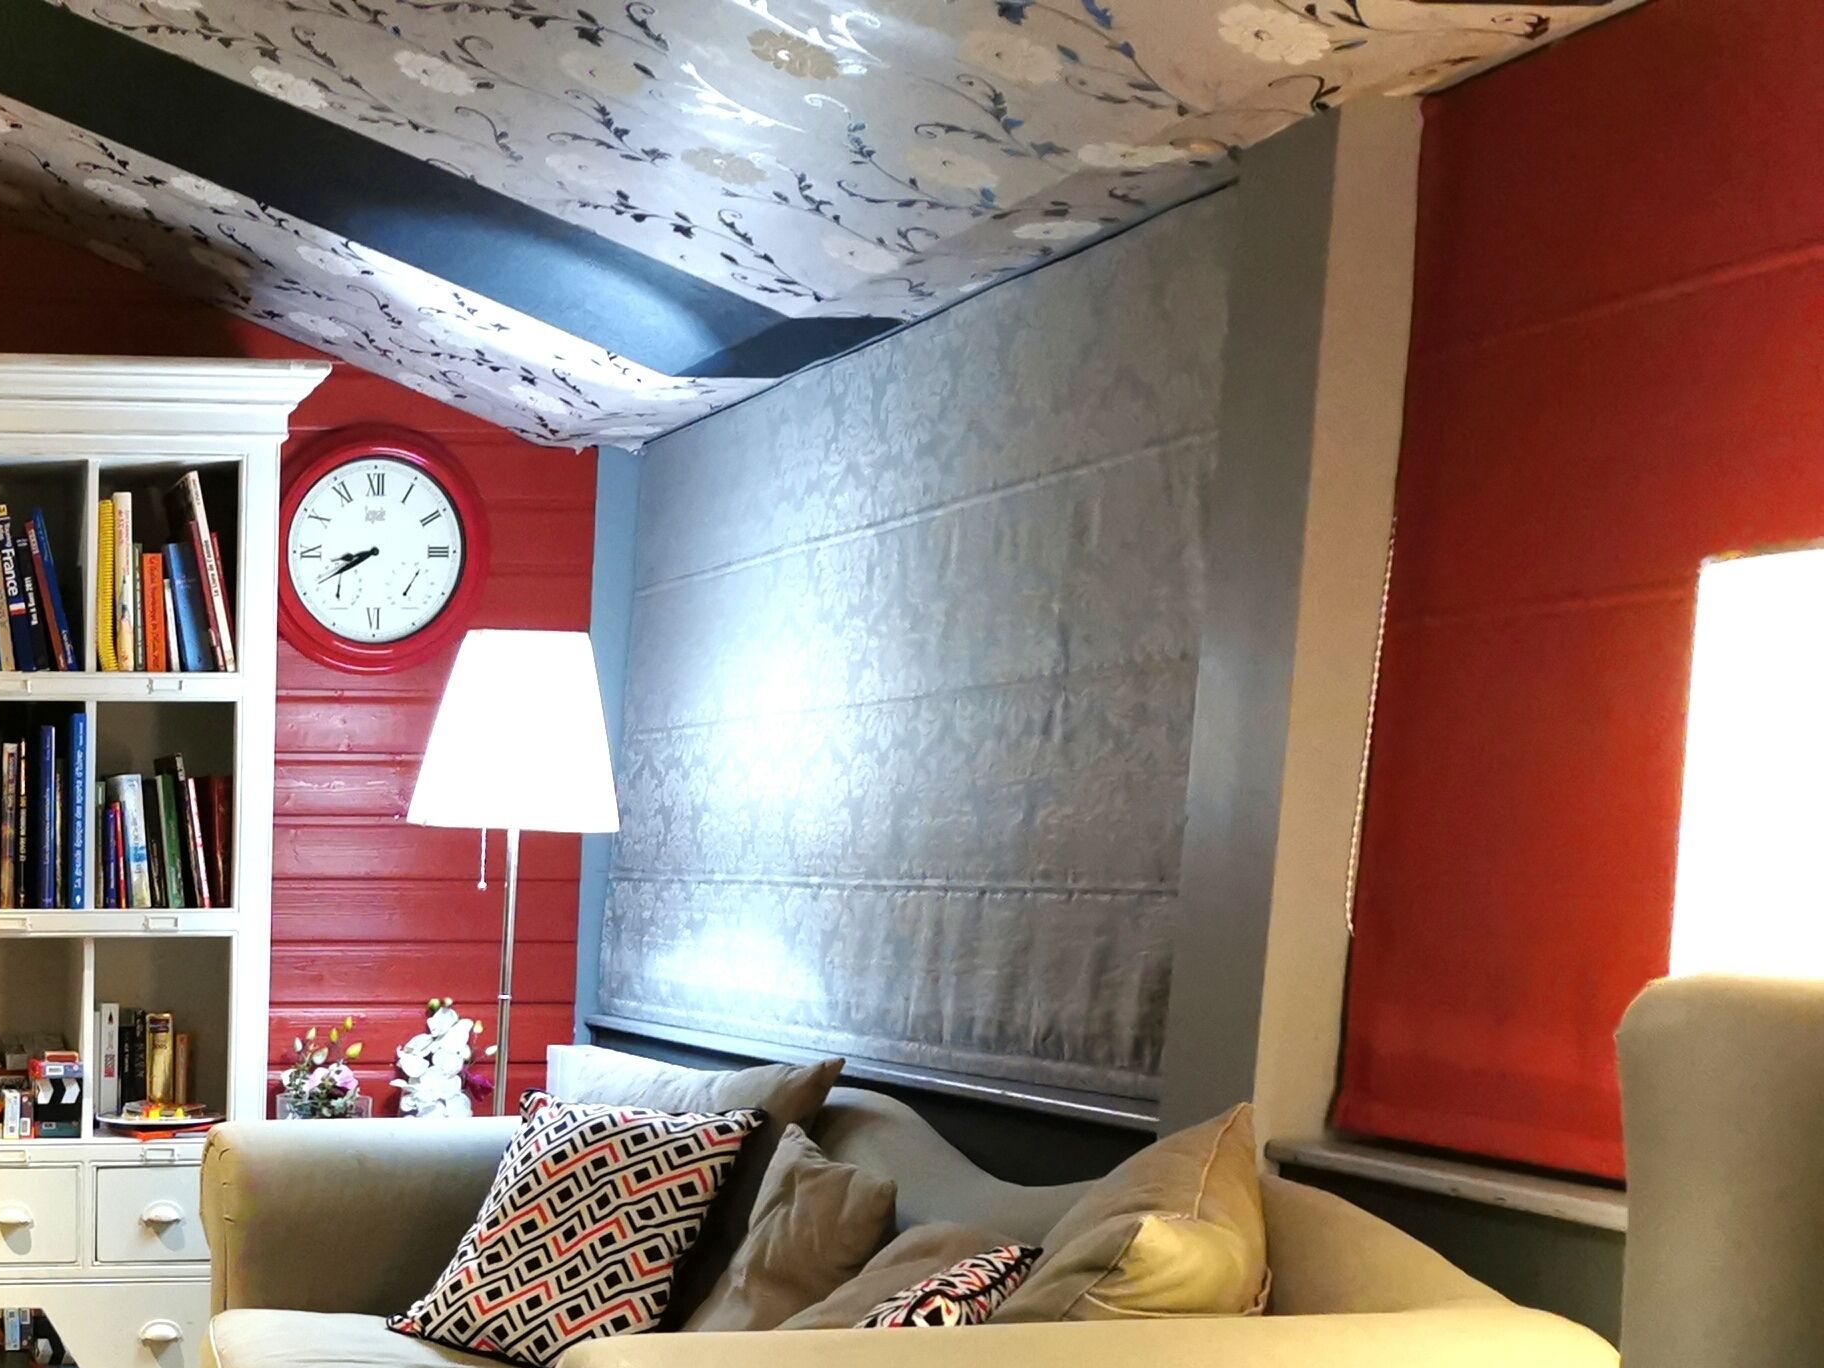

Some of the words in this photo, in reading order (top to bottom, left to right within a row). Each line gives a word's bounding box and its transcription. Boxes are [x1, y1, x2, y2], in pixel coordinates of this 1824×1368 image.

[366, 473, 385, 497] XII
[427, 544, 449, 558] III
[1, 548, 19, 597] France
